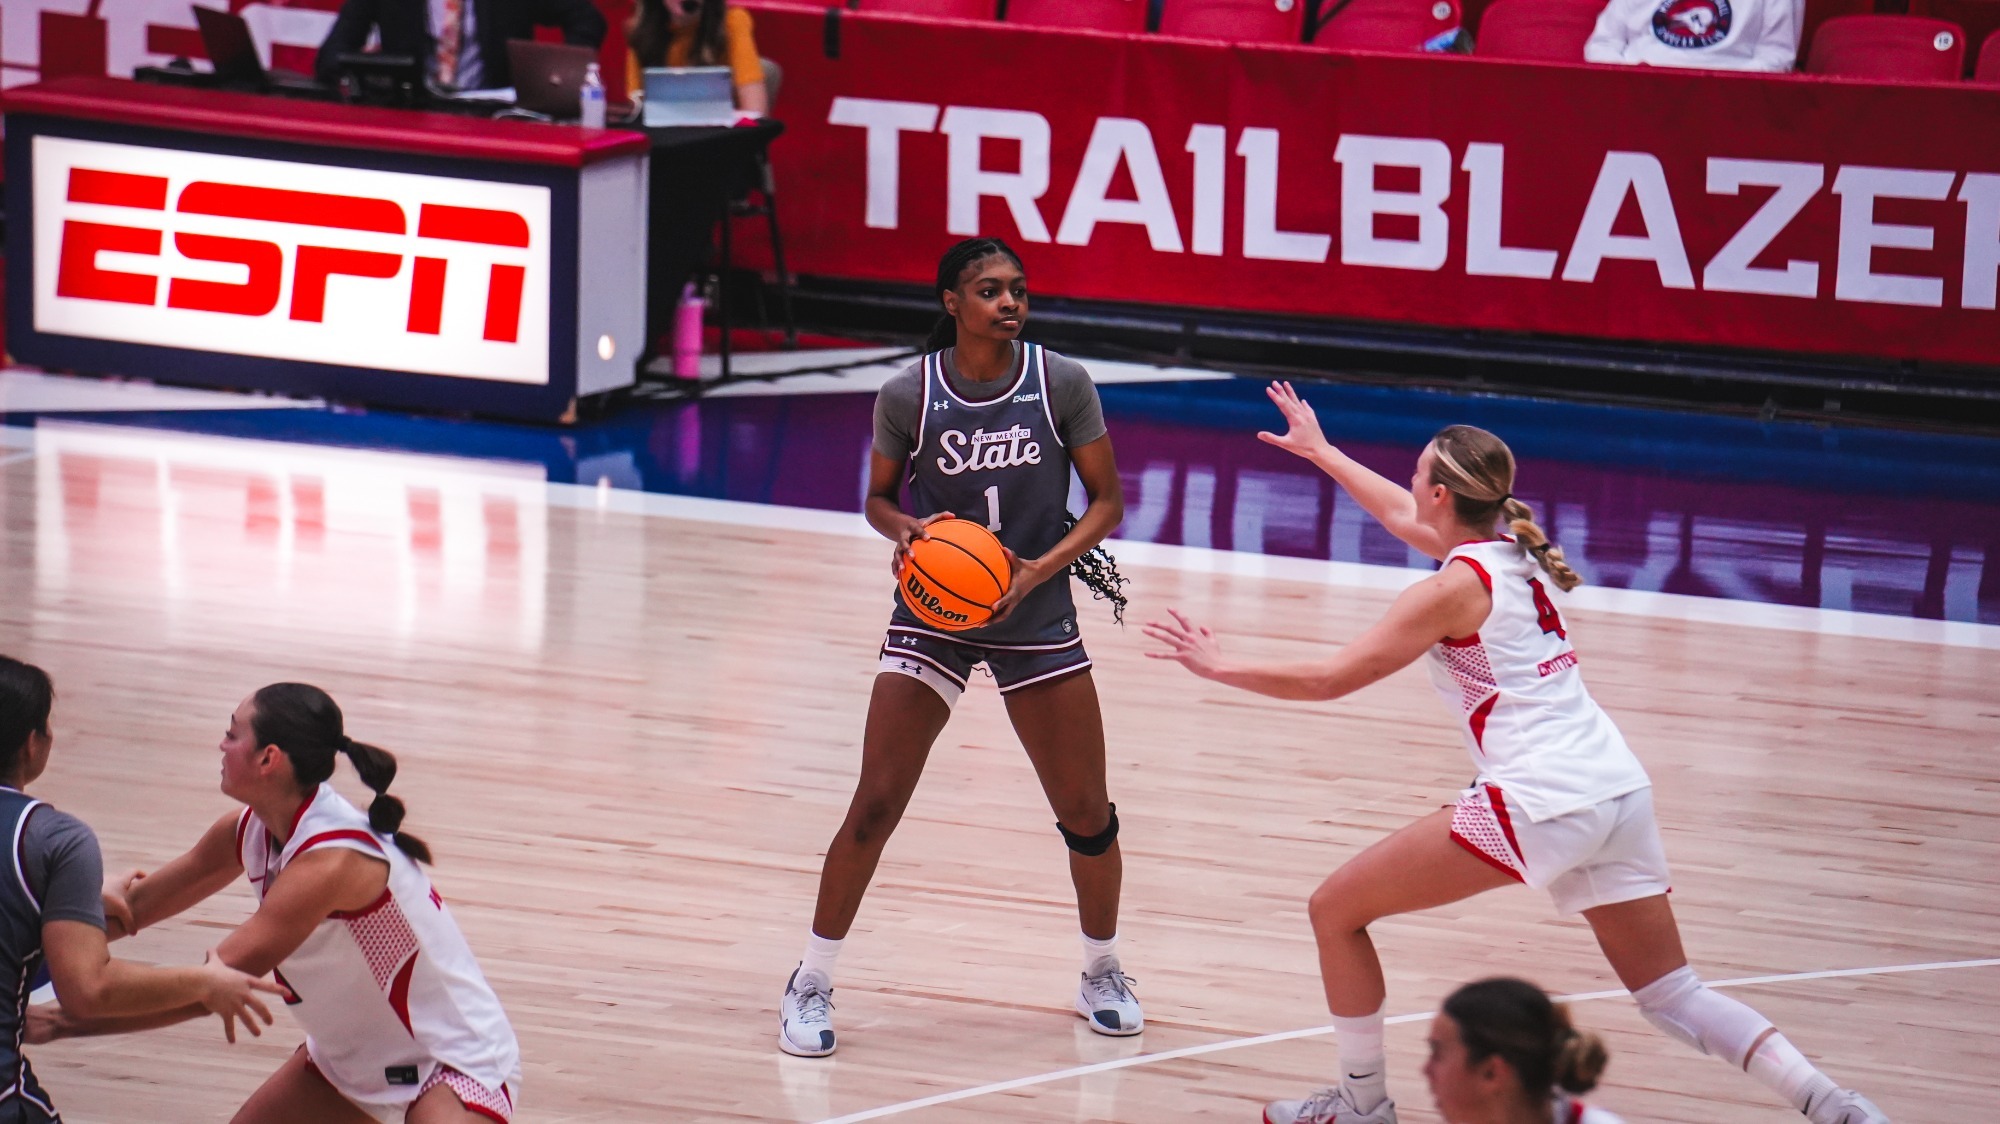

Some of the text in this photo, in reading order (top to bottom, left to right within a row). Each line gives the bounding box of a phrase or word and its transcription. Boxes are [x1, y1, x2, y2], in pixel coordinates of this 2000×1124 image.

[57, 167, 530, 343] ESPN
[936, 423, 1042, 476] State
[973, 430, 1029, 443] NEW MEXICO
[984, 485, 1002, 533] 1
[907, 572, 969, 623] Wilson
[1526, 576, 1566, 641] 4
